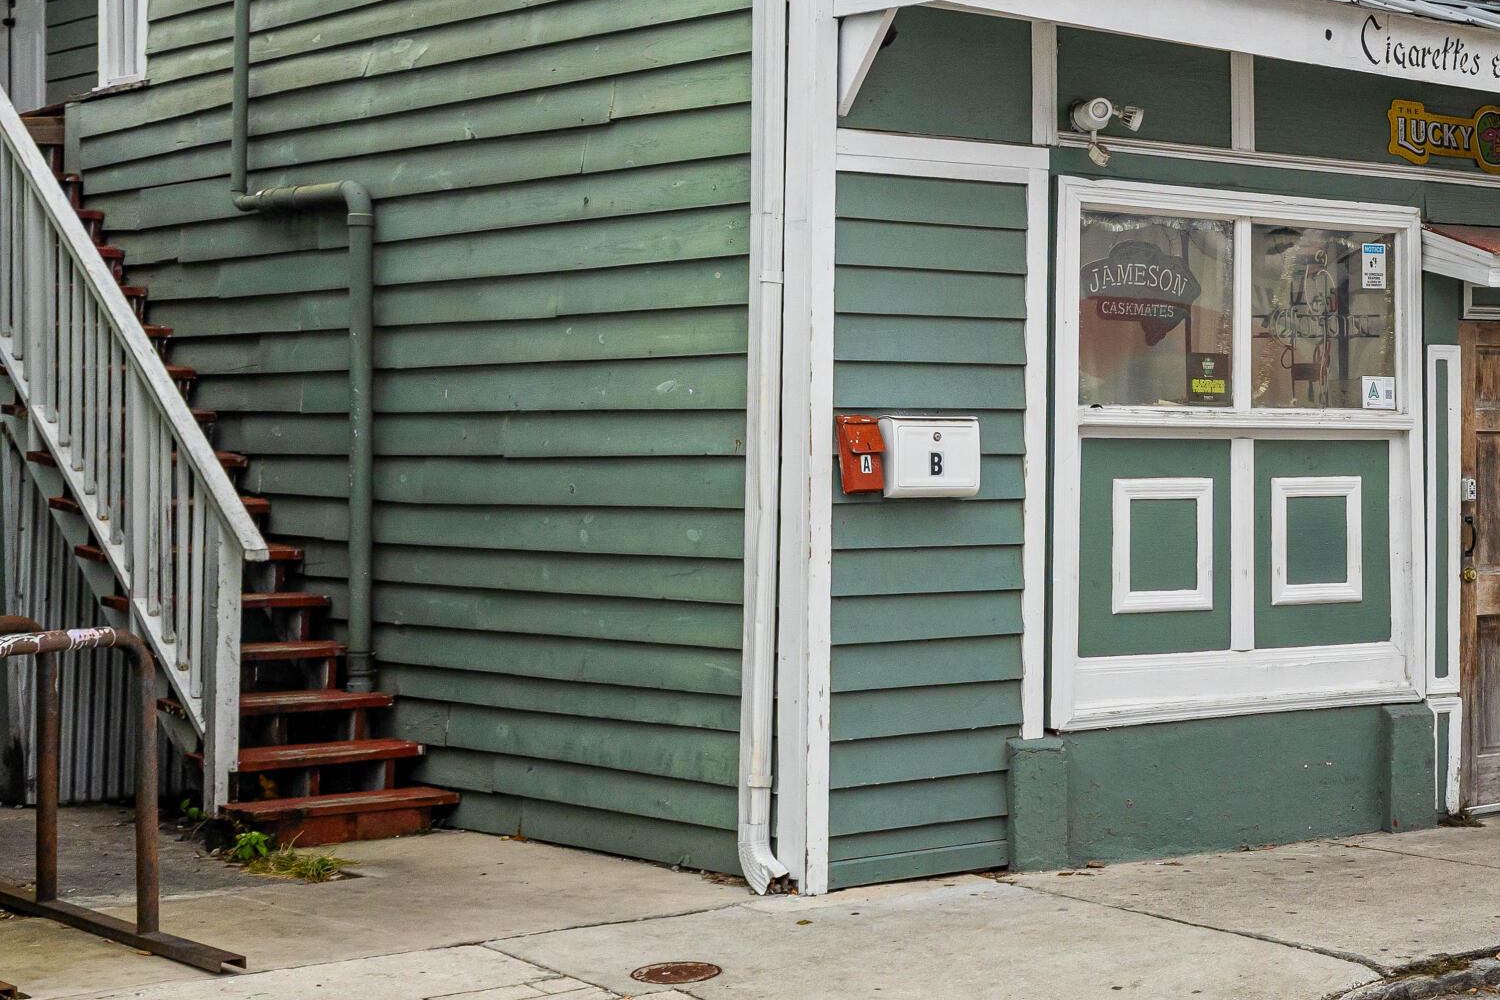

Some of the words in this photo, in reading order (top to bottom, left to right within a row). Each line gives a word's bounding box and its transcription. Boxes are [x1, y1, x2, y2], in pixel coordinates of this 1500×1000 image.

[1361, 14, 1481, 76] Cigarettes
[1400, 106, 1420, 115] THE
[1398, 116, 1474, 155] LUCKY
[1090, 263, 1188, 296] JAMESON
[1102, 301, 1175, 318] CASKMATES
[1368, 381, 1380, 398] A
[863, 456, 871, 473] A
[931, 452, 943, 476] B
